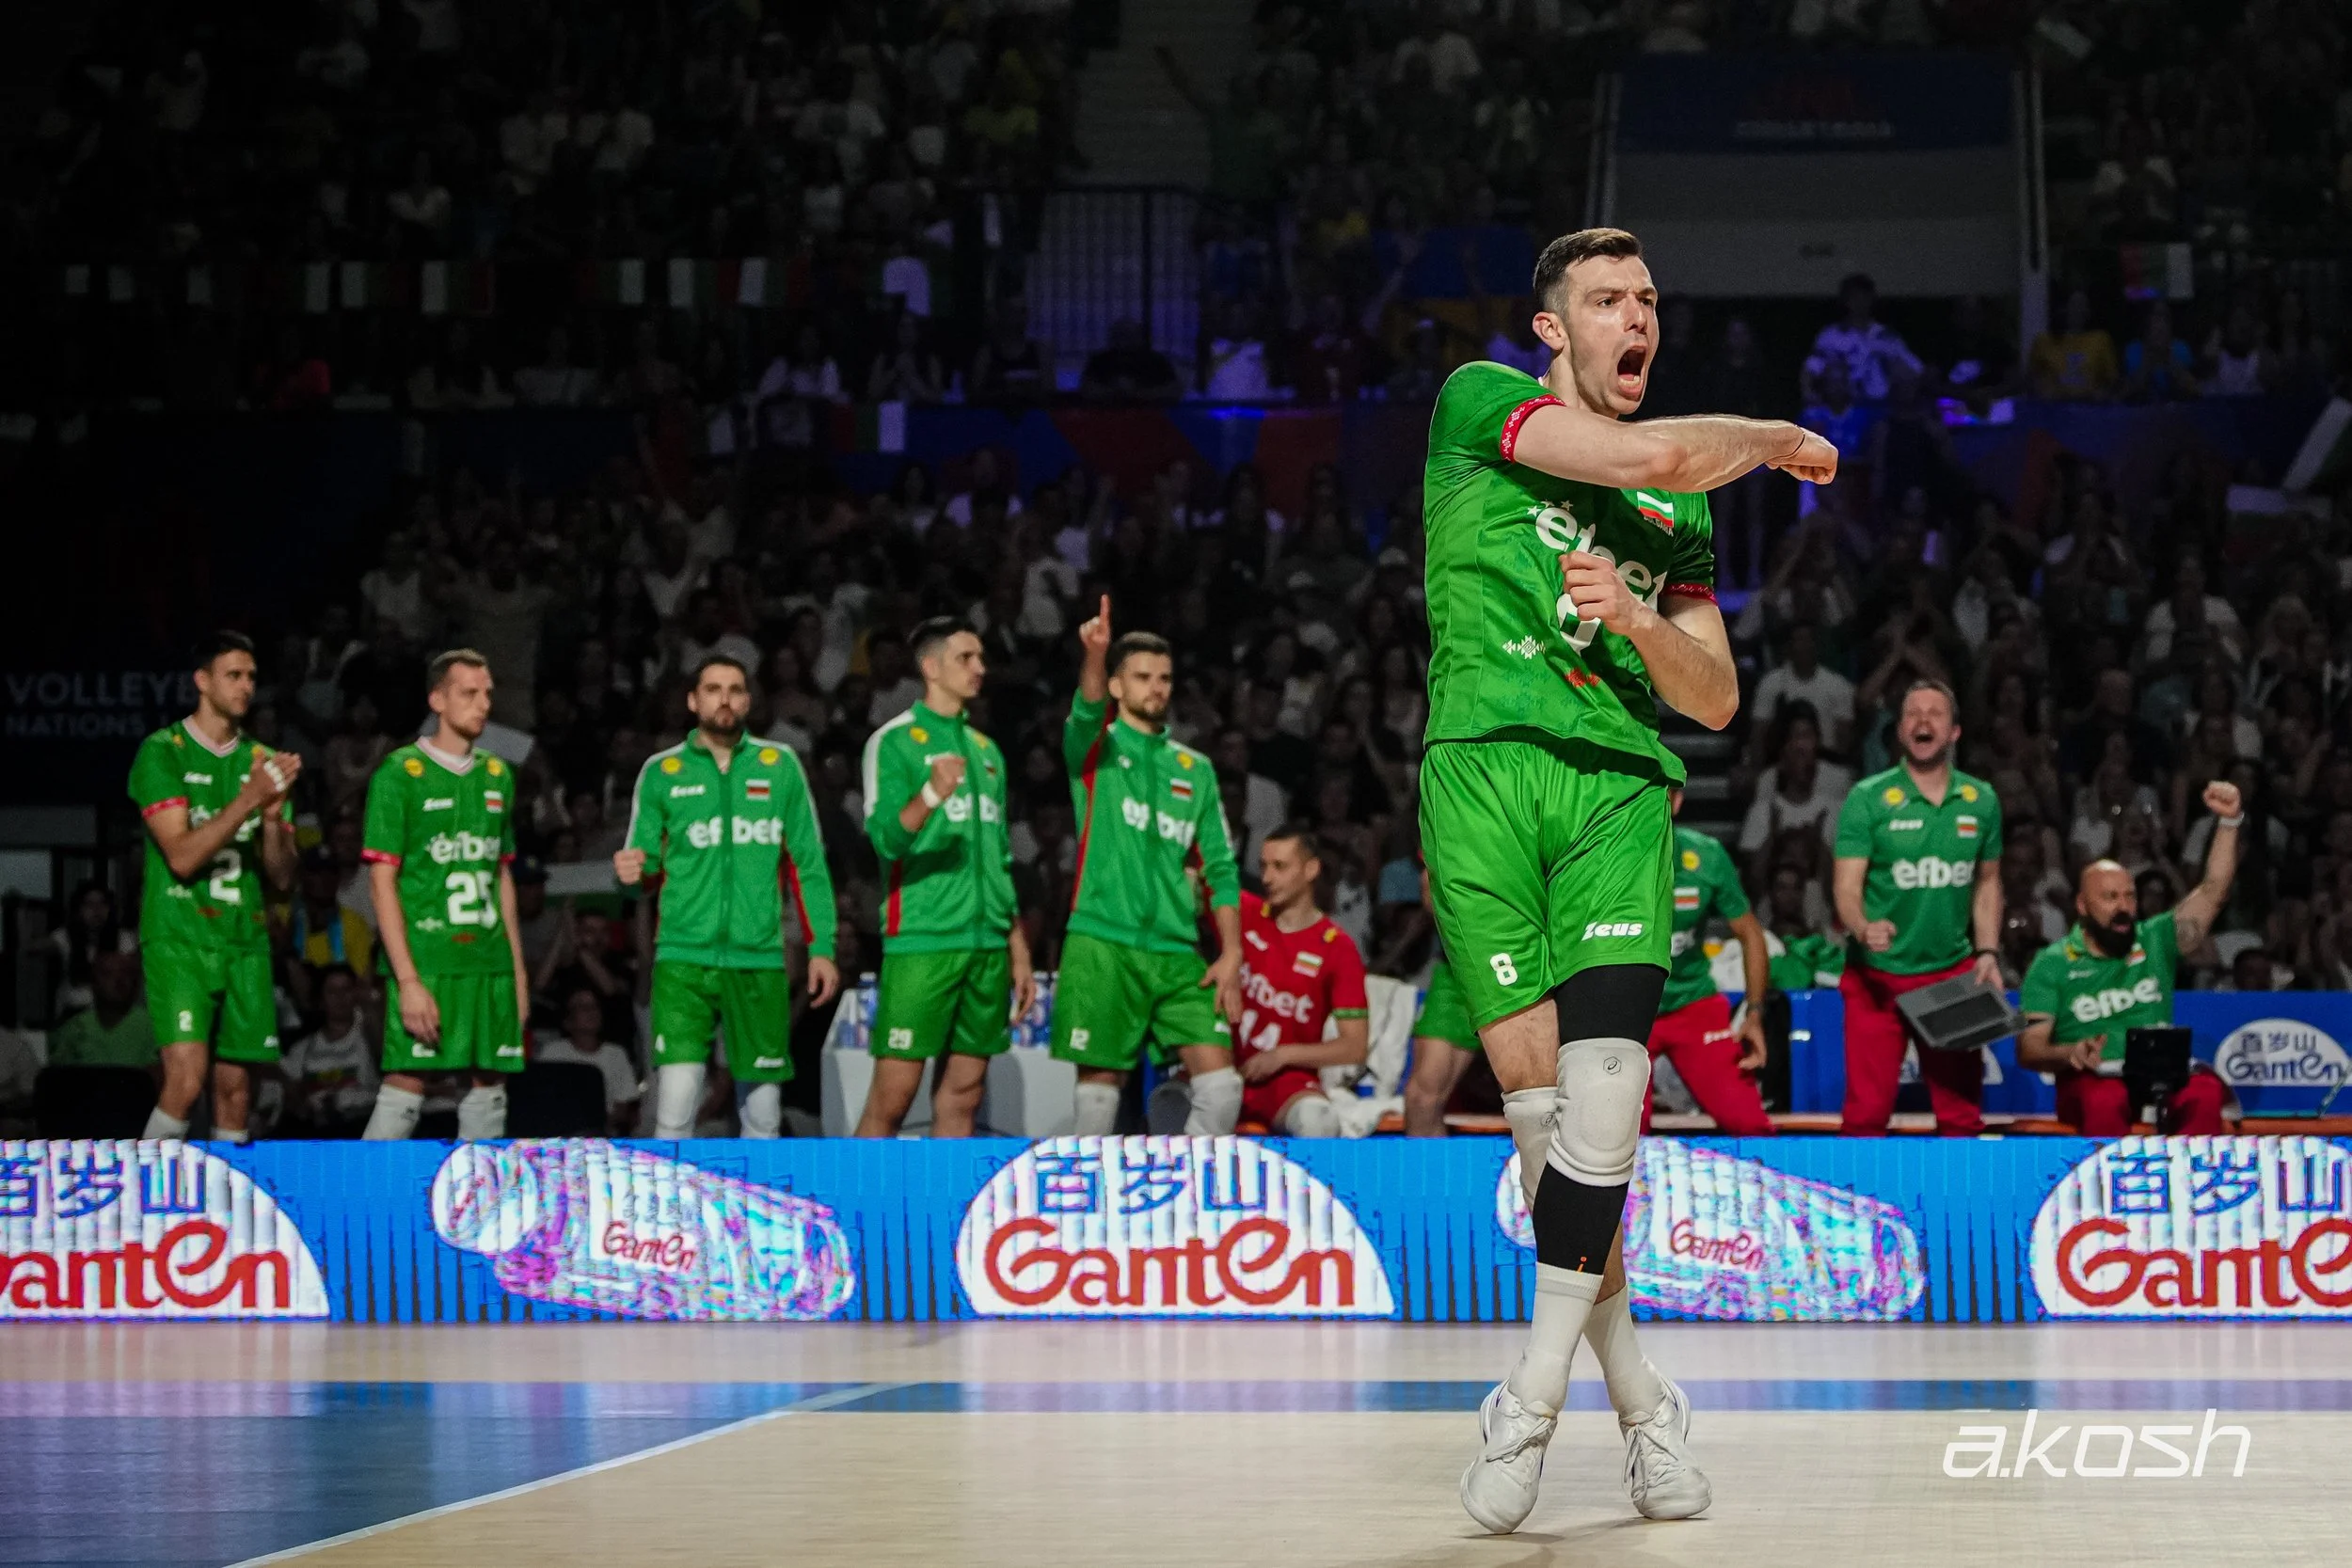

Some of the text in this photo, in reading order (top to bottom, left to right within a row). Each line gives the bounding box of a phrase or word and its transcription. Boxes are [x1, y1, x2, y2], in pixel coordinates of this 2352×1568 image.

[5, 712, 146, 738] NATIONS
[209, 847, 242, 905] 2
[1489, 952, 1518, 987] 8
[1035, 1154, 1268, 1214] 百岁山
[2107, 1150, 2343, 1215] 百岁山
[0, 1219, 291, 1309] anten
